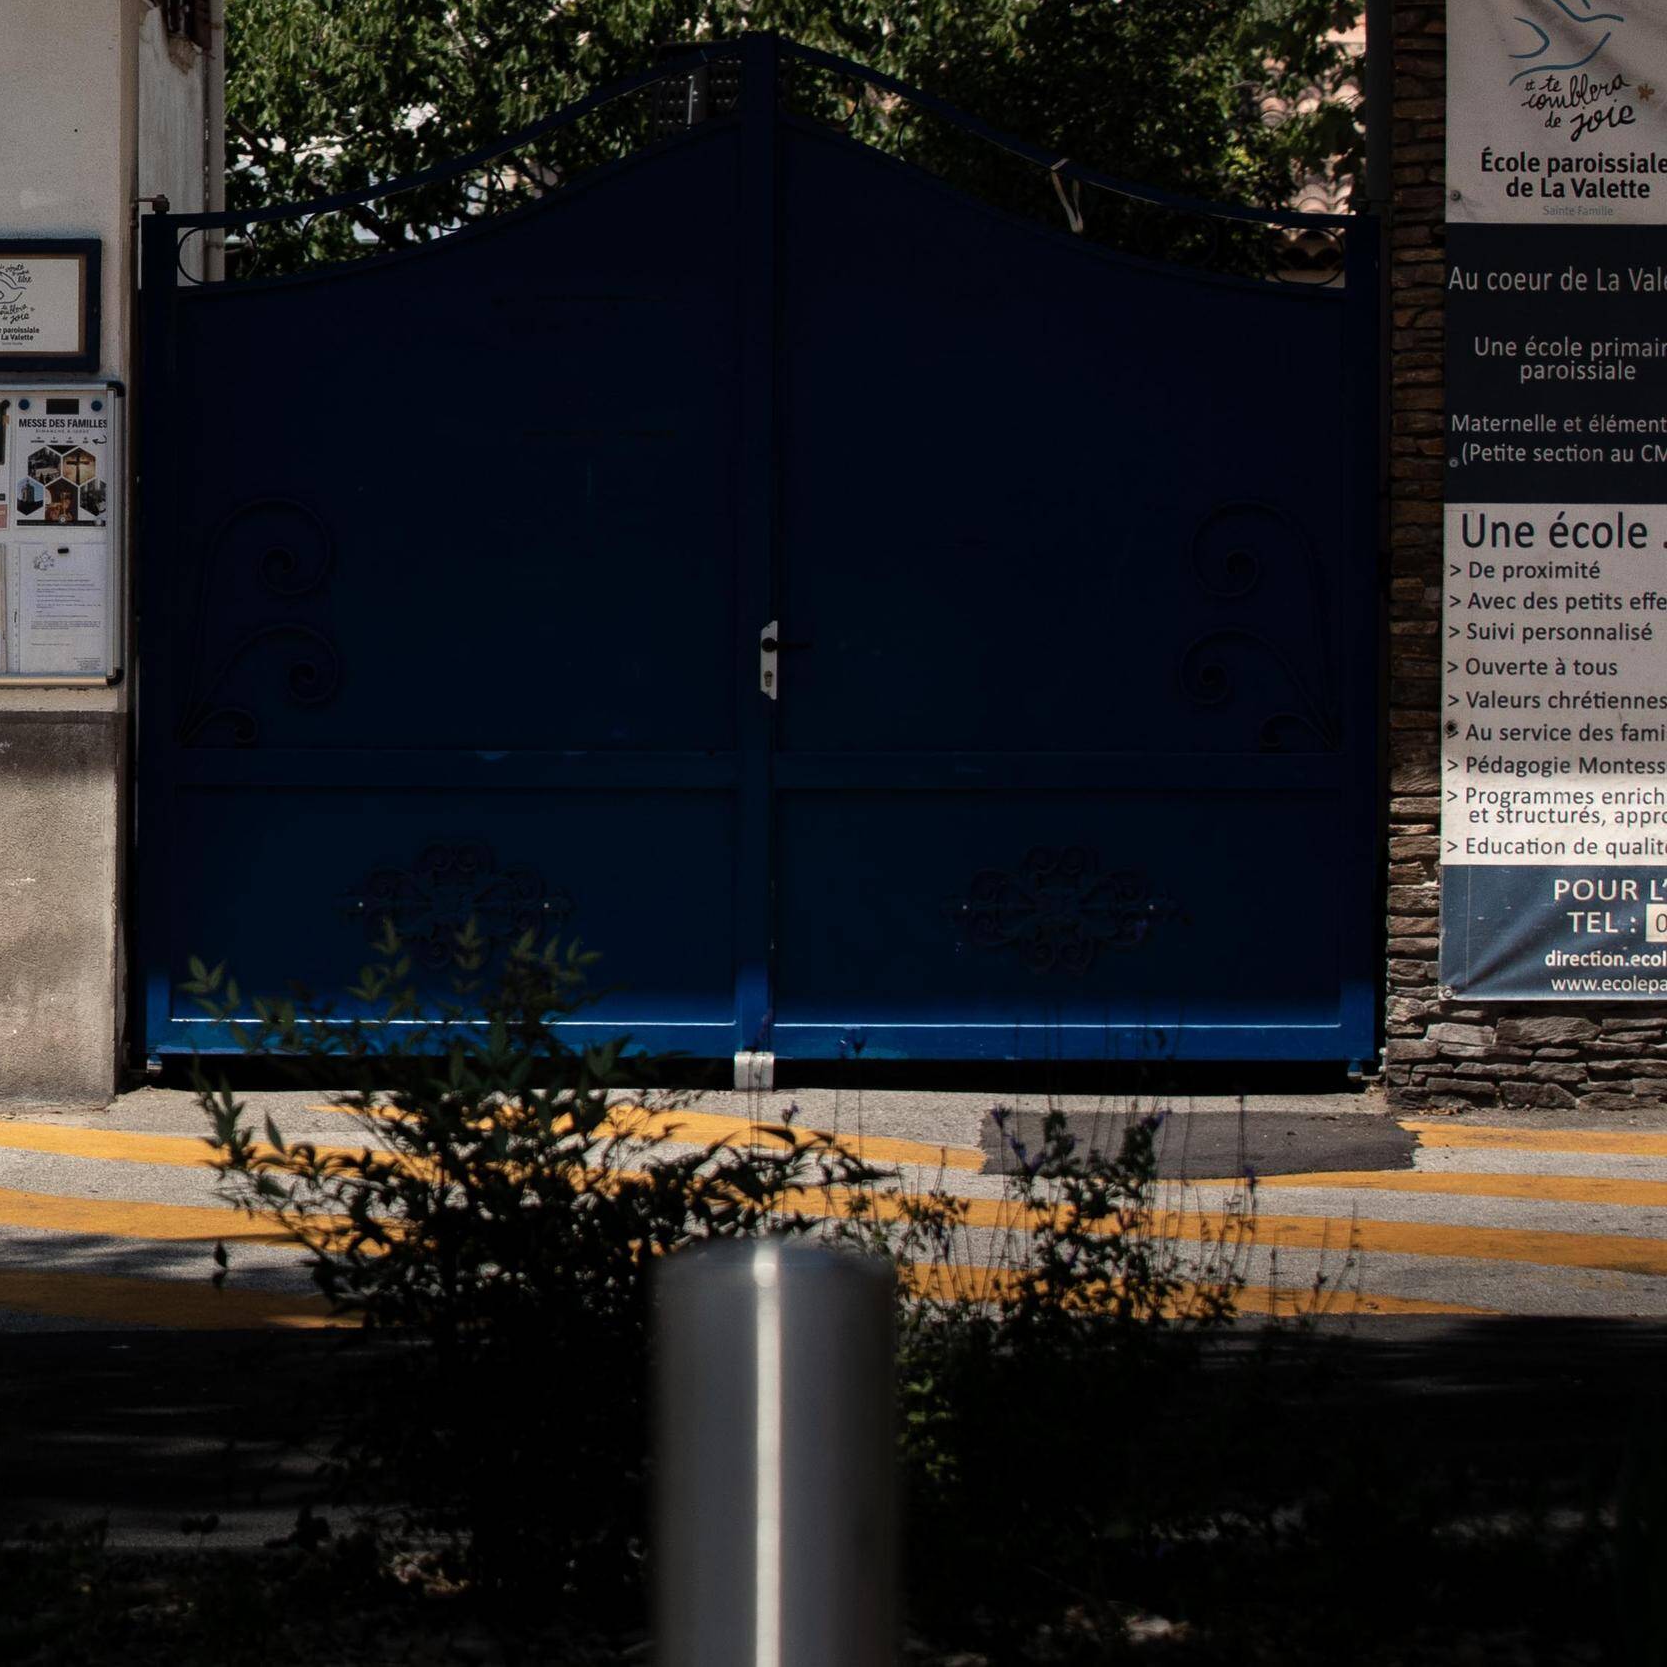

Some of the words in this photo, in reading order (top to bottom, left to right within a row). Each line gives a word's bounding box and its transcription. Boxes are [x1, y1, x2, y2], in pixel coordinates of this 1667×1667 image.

[1521, 73, 1632, 109] comblera
[1539, 75, 1562, 92] te
[1545, 112, 1562, 128] de
[1570, 97, 1636, 142] joie
[1482, 147, 1540, 172] École
[1506, 177, 1533, 197] de
[1541, 176, 1565, 198] La
[1571, 178, 1650, 200] Valette
[1543, 205, 1575, 216] Sainte
[1578, 205, 1613, 216] Famille
[1449, 267, 1477, 290] Au
[1488, 273, 1552, 290] coeur
[1561, 266, 1587, 291] de
[1598, 268, 1619, 291] La
[1628, 267, 1667, 291] Val
[0, 333, 8, 341] La
[10, 333, 34, 341] Valette
[2, 326, 41, 335] paroissiale
[1475, 337, 1516, 356] Une
[1525, 336, 1582, 356] école
[1520, 360, 1636, 384] paroissiale
[18, 419, 47, 427] MESSE
[49, 419, 65, 428] DES
[67, 419, 107, 428] FAMILLES
[1452, 414, 1556, 432] Maternelle
[1564, 417, 1581, 432] et
[1463, 443, 1526, 465] (Petite
[1534, 444, 1603, 461] section
[1611, 449, 1633, 462] au
[1462, 512, 1535, 549] Une
[1549, 511, 1647, 549] école
[1469, 562, 1494, 578] De
[1503, 561, 1600, 582] proximité
[1468, 593, 1516, 609] Avec
[1523, 592, 1558, 609] des
[1566, 593, 1622, 613] petits
[1467, 623, 1514, 639] Suivi
[1523, 623, 1652, 644] personnalisé
[1466, 658, 1547, 675] Ouverte
[1556, 658, 1565, 675] à
[1573, 660, 1617, 675] tous
[1466, 691, 1540, 708] Valeurs
[1466, 724, 1491, 740] Au
[1500, 724, 1571, 741] service
[1579, 723, 1613, 741] des
[1466, 756, 1571, 777] Pédagogie
[1578, 756, 1666, 774] Montess
[1465, 787, 1594, 807] Programmes
[1602, 787, 1664, 804] enrich
[1469, 809, 1490, 824] et
[1496, 807, 1607, 826] structurés,
[1467, 837, 1565, 854] Education
[1574, 837, 1597, 854] de
[1606, 837, 1667, 858] qualit
[1554, 879, 1638, 901] POUR
[1567, 912, 1619, 933] TEL
